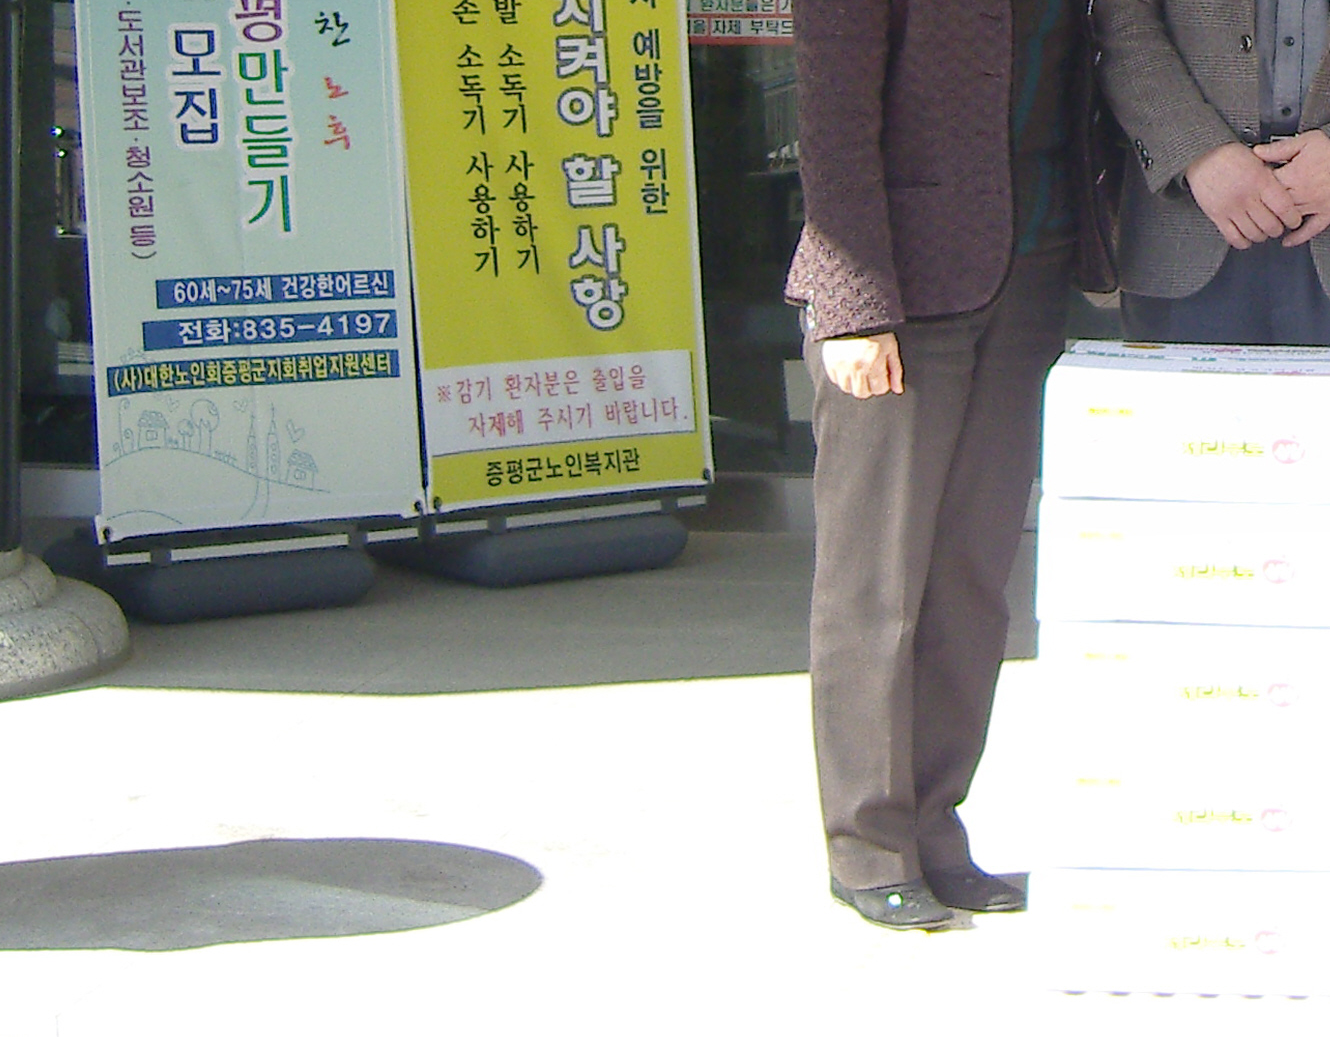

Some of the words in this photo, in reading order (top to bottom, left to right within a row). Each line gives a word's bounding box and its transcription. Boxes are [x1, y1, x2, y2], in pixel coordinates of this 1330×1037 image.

[713, 19, 742, 36] 자제
[171, 28, 222, 145] 모집
[322, 76, 351, 151] 노후
[456, 43, 486, 135] 소독기
[497, 42, 528, 134] 소독기
[633, 28, 665, 131] 예방을
[465, 151, 501, 278] 사용하기
[505, 150, 541, 275] 사용하기
[562, 152, 622, 209] 할
[639, 147, 670, 216] 위한
[173, 275, 273, 304] 60세~75세
[568, 223, 628, 331] 사항
[177, 312, 392, 346] 전화:835-4197
[468, 408, 525, 438] 자제해
[538, 403, 593, 432] 주시기
[604, 396, 689, 425] 바랍니다.
[504, 368, 581, 400] 환자분은
[592, 364, 648, 393] 출입을
[485, 447, 641, 487] 증평군노인복지관
